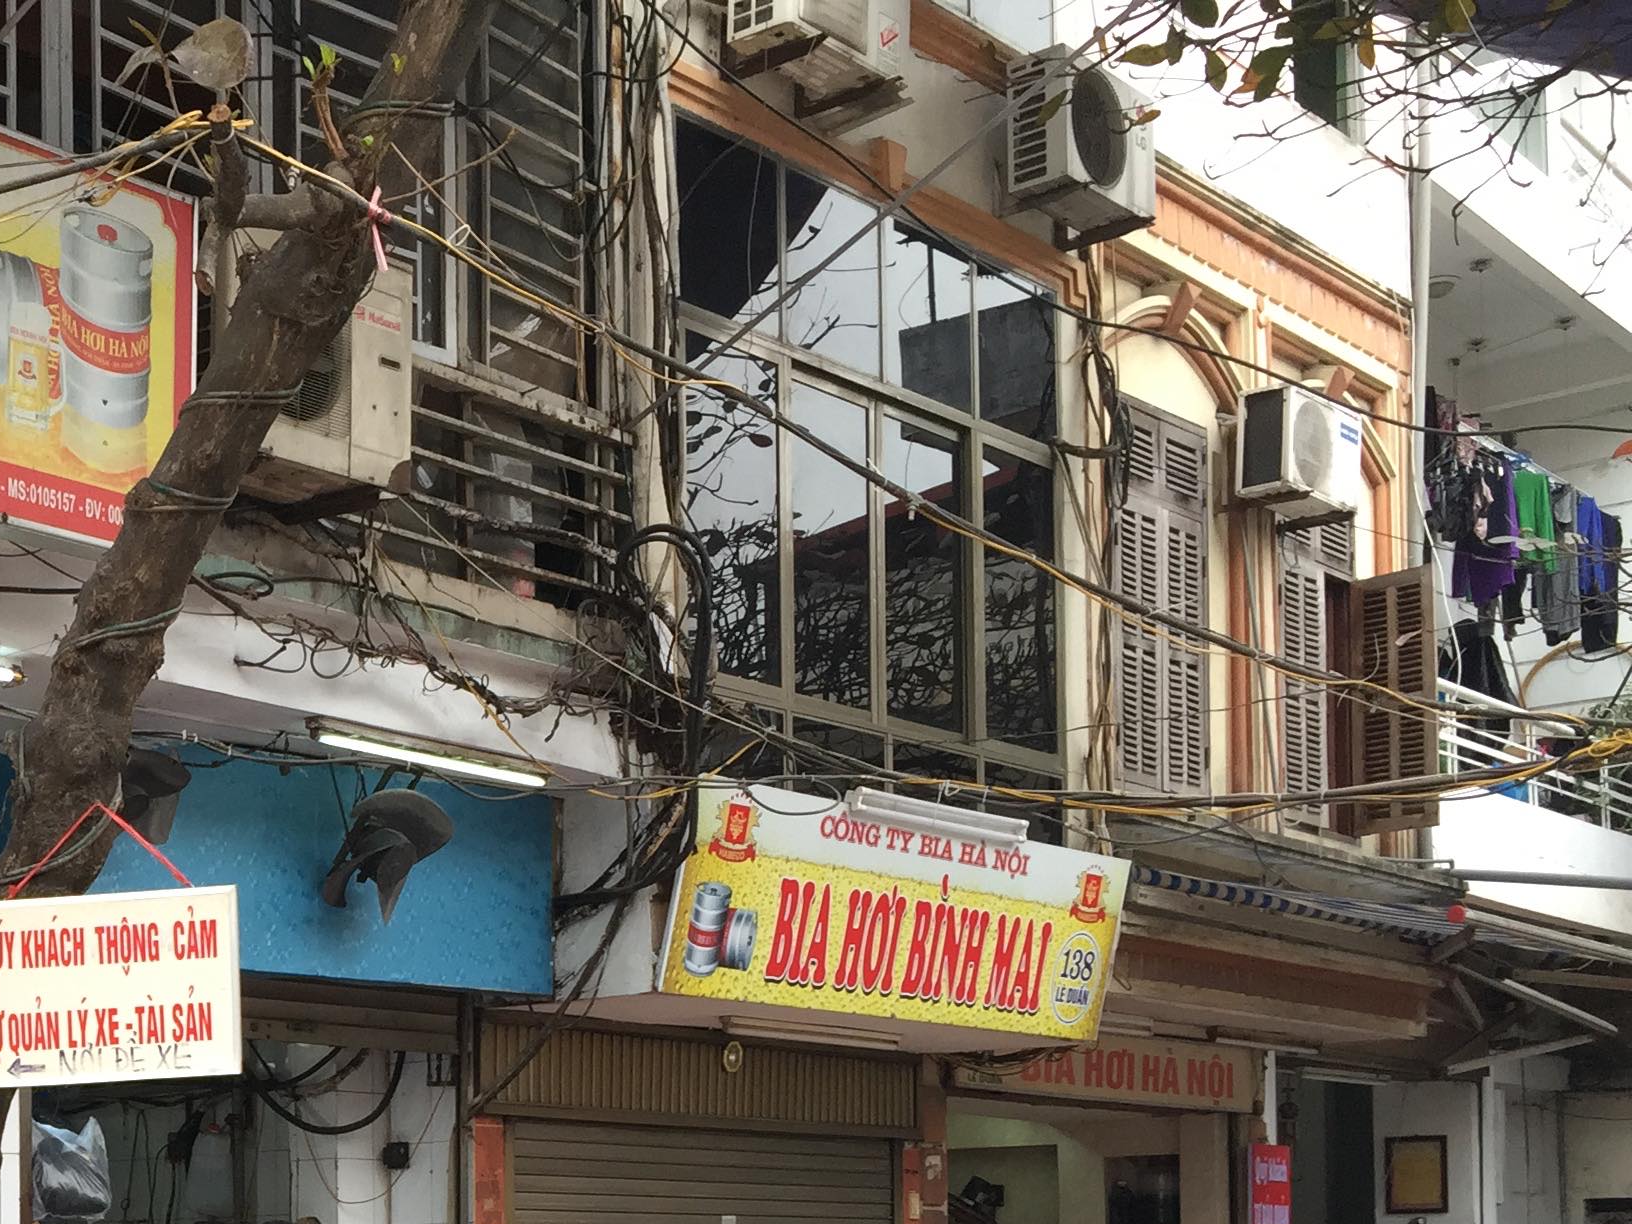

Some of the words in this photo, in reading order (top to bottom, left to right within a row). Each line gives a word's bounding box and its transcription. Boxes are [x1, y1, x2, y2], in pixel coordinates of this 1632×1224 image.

[820, 811, 880, 847] CÔNG
[886, 827, 915, 853] TY
[918, 834, 954, 861] BIA
[959, 839, 987, 868] HÀ
[992, 846, 1031, 878] NỘI
[21, 915, 85, 968] KHÁCH
[173, 905, 218, 960] CẢM
[765, 876, 832, 985] BIA
[834, 885, 907, 995] HƠI
[983, 911, 1053, 1013] MAI
[1061, 948, 1095, 981] 138
[8, 996, 60, 1056] QUẢN
[67, 997, 88, 1048] LÝ
[95, 1007, 119, 1046] XE
[172, 985, 212, 1041] SẢN
[1084, 1049, 1135, 1090] HƠI
[1187, 1054, 1234, 1105] NỘI
